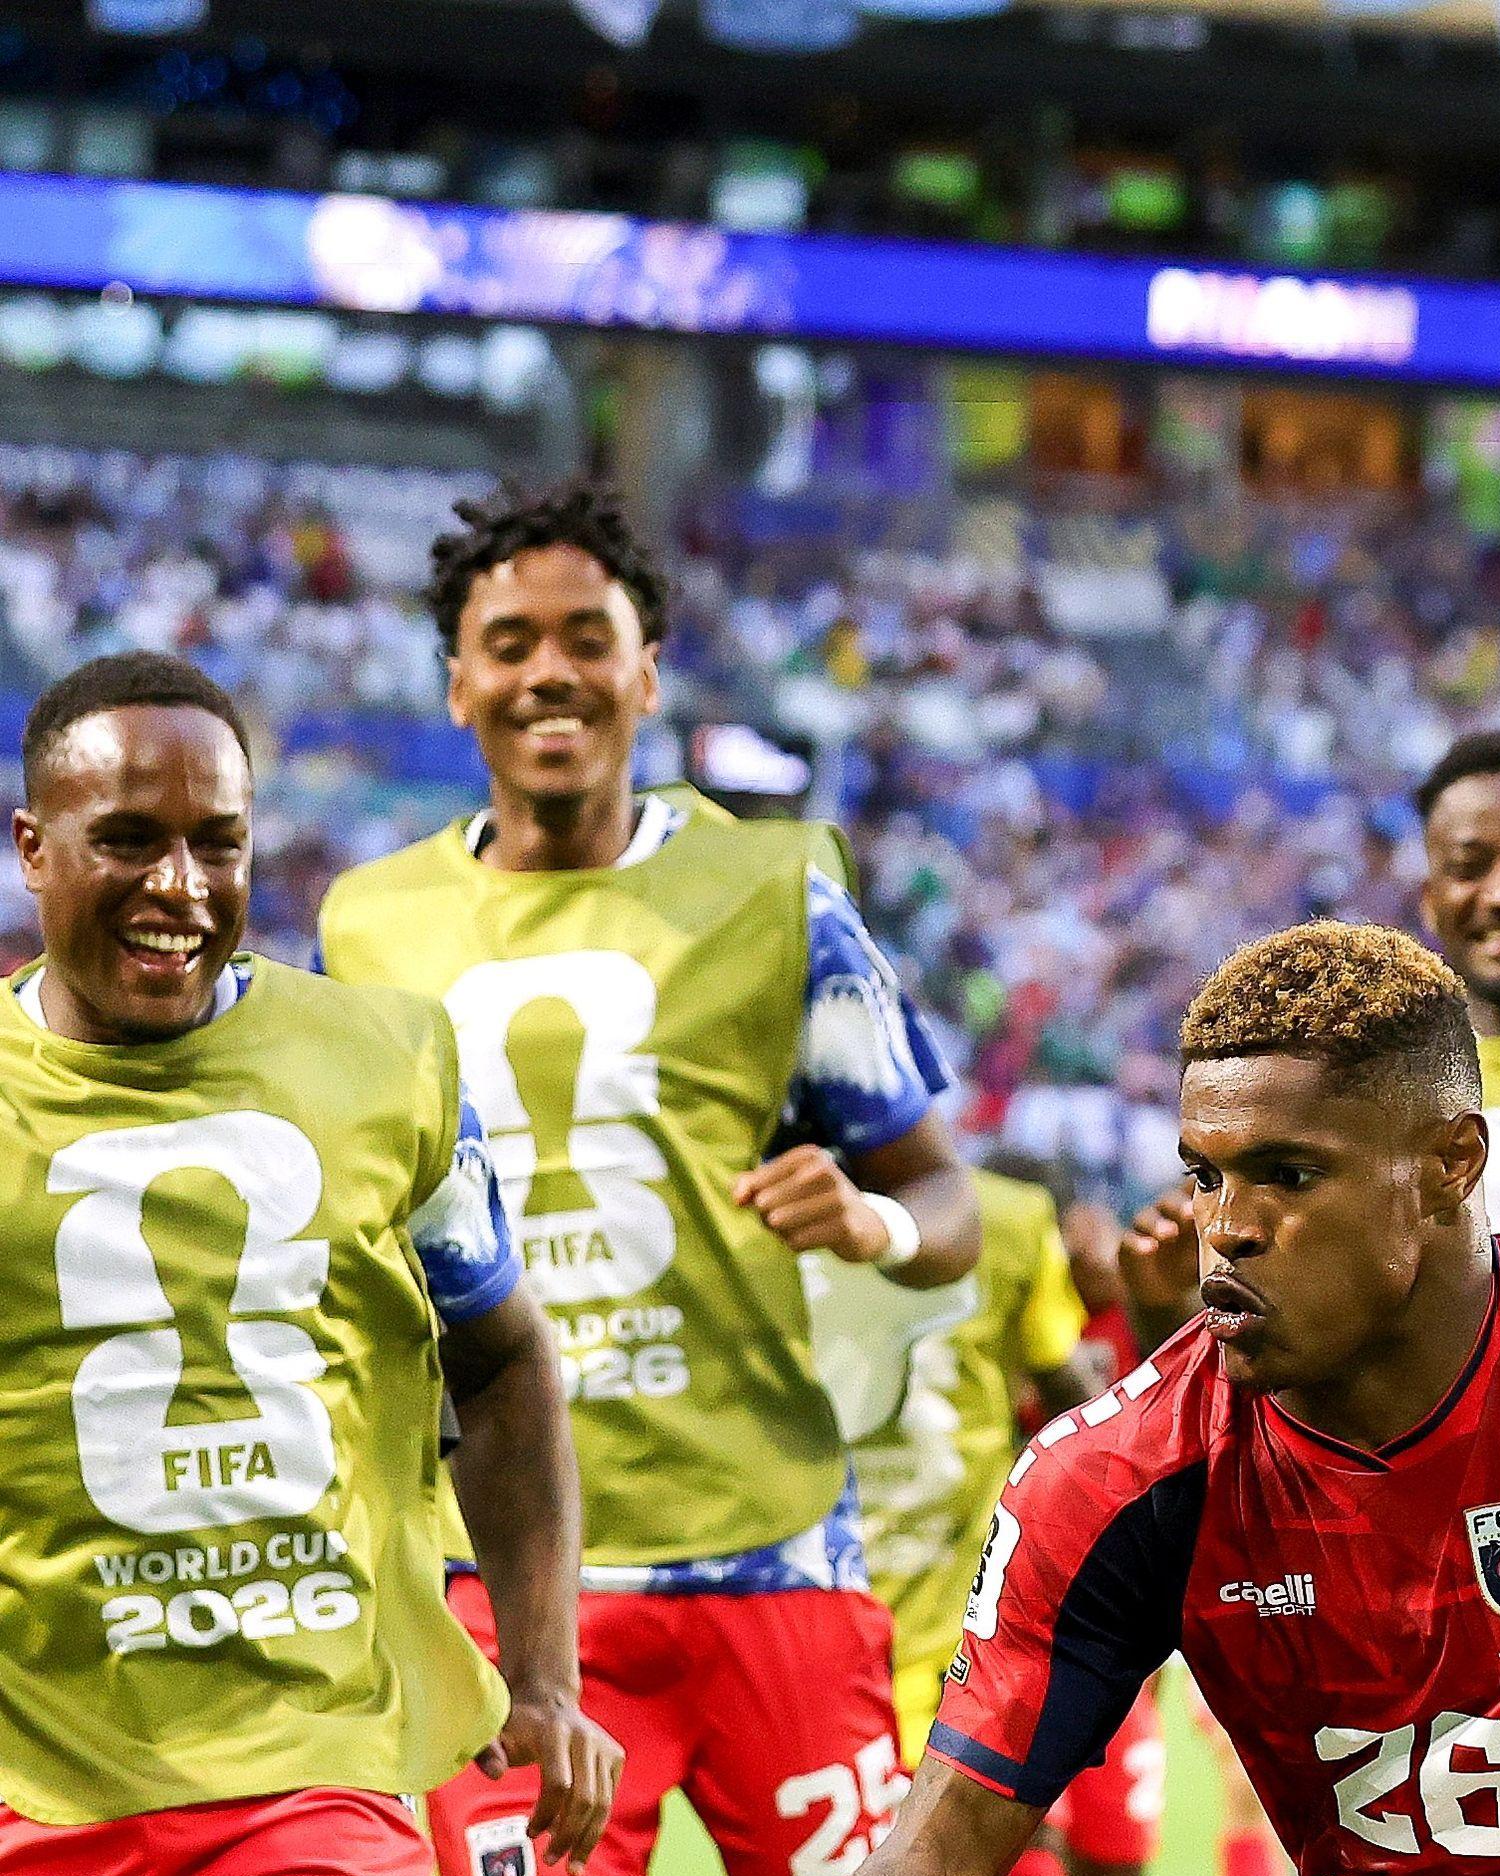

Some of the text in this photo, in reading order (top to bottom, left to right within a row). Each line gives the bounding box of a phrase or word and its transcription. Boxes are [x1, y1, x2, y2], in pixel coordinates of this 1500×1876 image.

[523, 1230, 614, 1270] FIFA
[161, 1441, 278, 1491] FIFA
[94, 1530, 349, 1587] WORLD CUP
[101, 1571, 362, 1654] 2026
